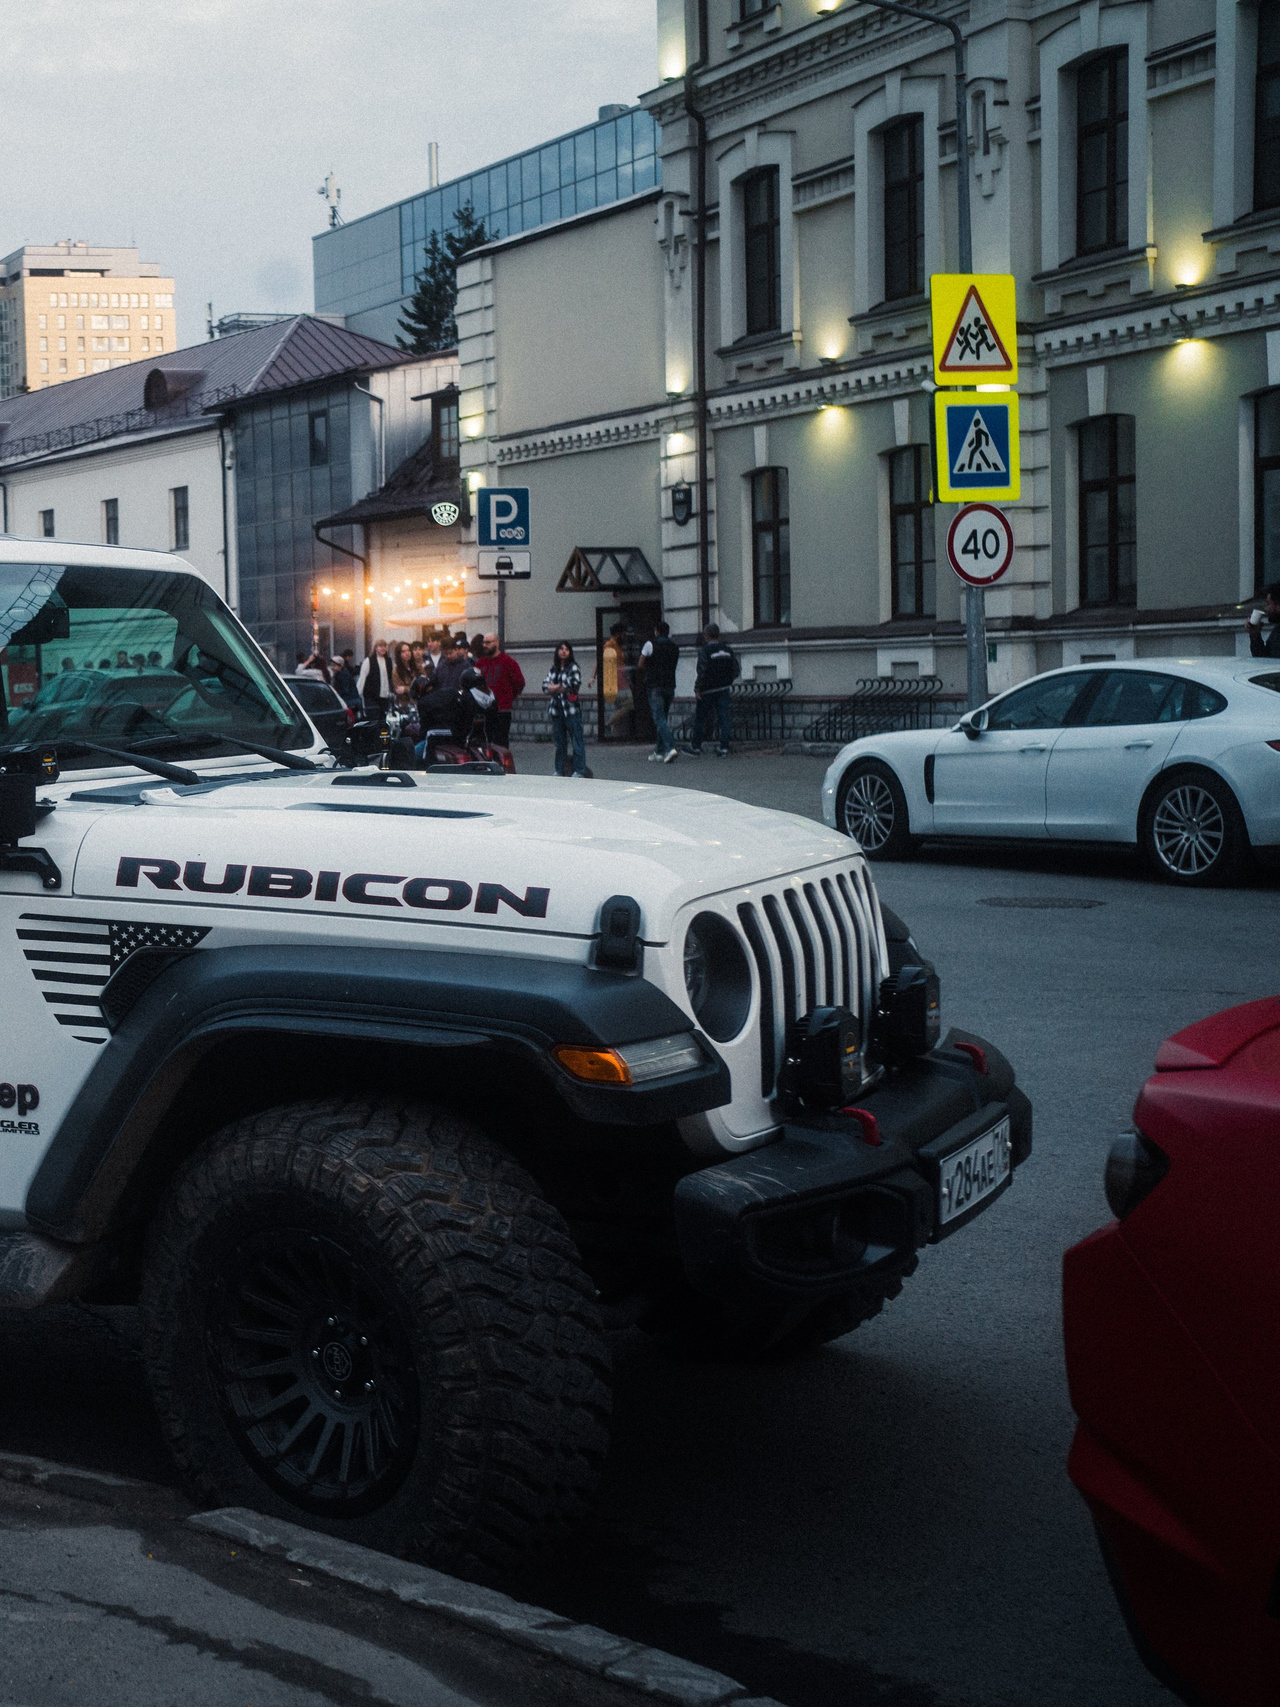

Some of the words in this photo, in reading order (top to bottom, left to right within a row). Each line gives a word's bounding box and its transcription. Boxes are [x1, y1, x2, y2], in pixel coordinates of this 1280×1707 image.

[489, 494, 518, 541] P
[961, 528, 1000, 561] 40
[115, 856, 551, 918] RUBICON
